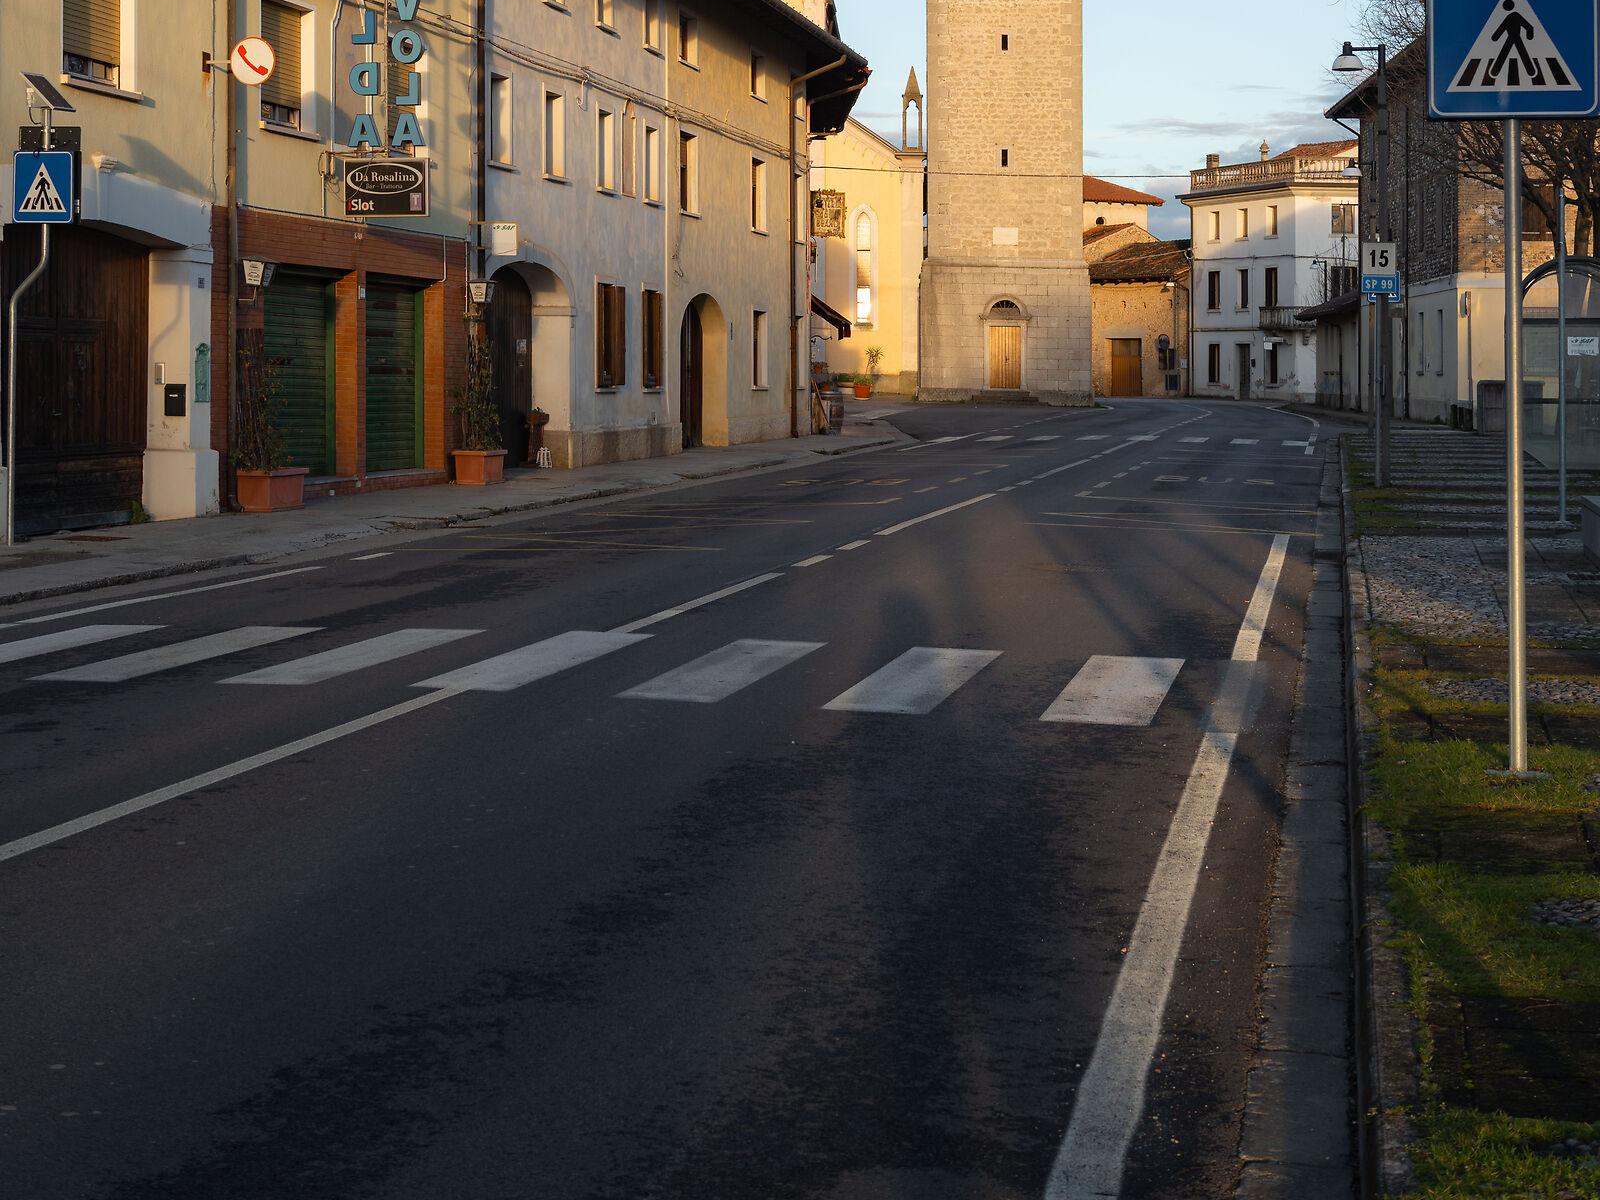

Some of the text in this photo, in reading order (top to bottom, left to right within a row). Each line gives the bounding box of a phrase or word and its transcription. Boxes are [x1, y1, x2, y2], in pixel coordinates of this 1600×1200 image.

[356, 172, 415, 182] Da Rosalina
[348, 199, 374, 210] iSlot
[1370, 250, 1388, 268] 15
[1366, 280, 1392, 290] SP 99
